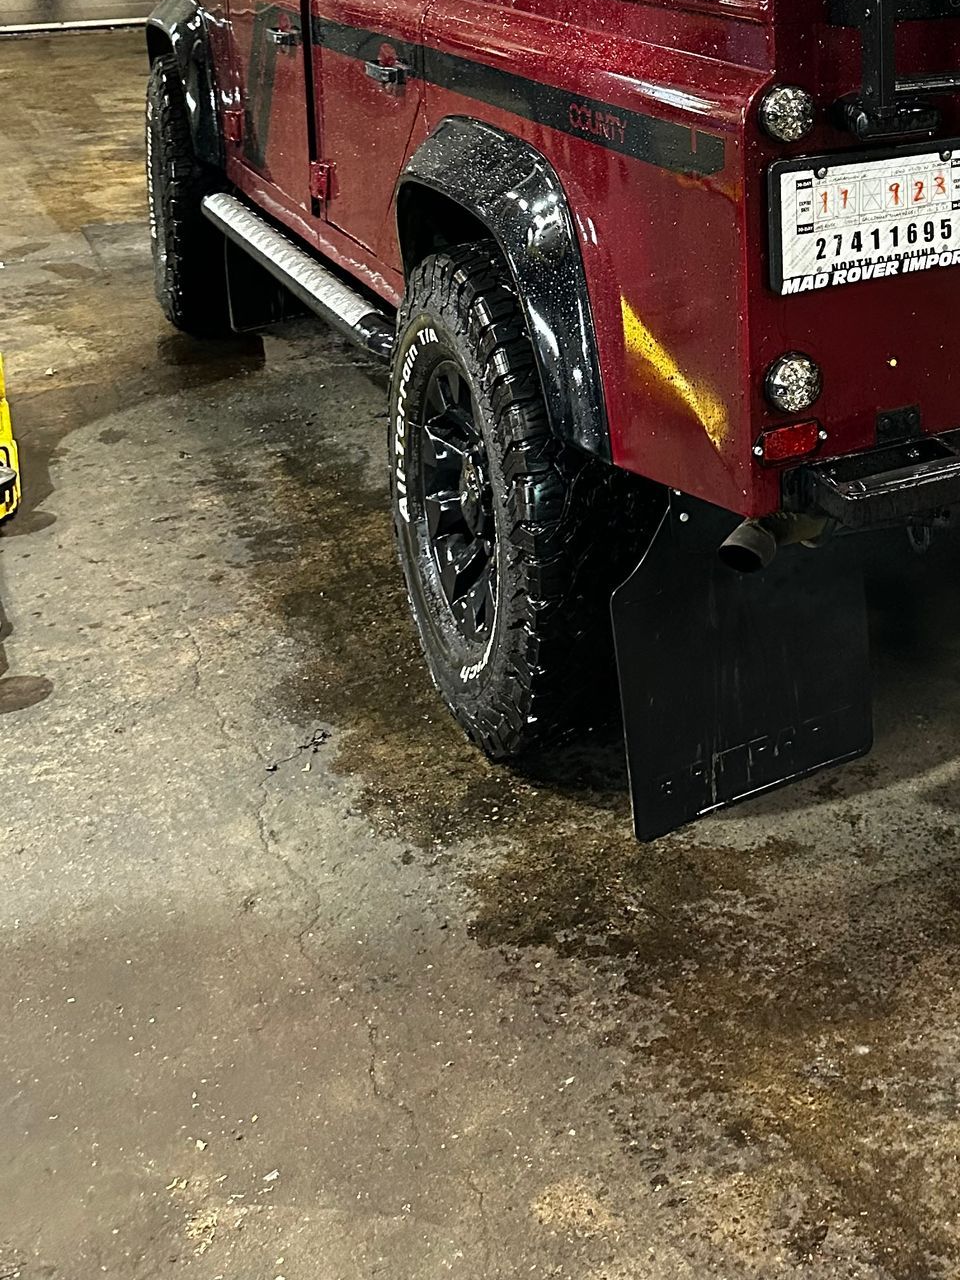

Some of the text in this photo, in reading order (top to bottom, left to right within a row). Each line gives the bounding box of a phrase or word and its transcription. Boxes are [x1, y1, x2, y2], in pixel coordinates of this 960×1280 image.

[815, 218, 952, 260] 27411695
[781, 272, 829, 296] MAD
[832, 260, 899, 285] ROVER
[394, 327, 439, 523] All-Terrain T/A
